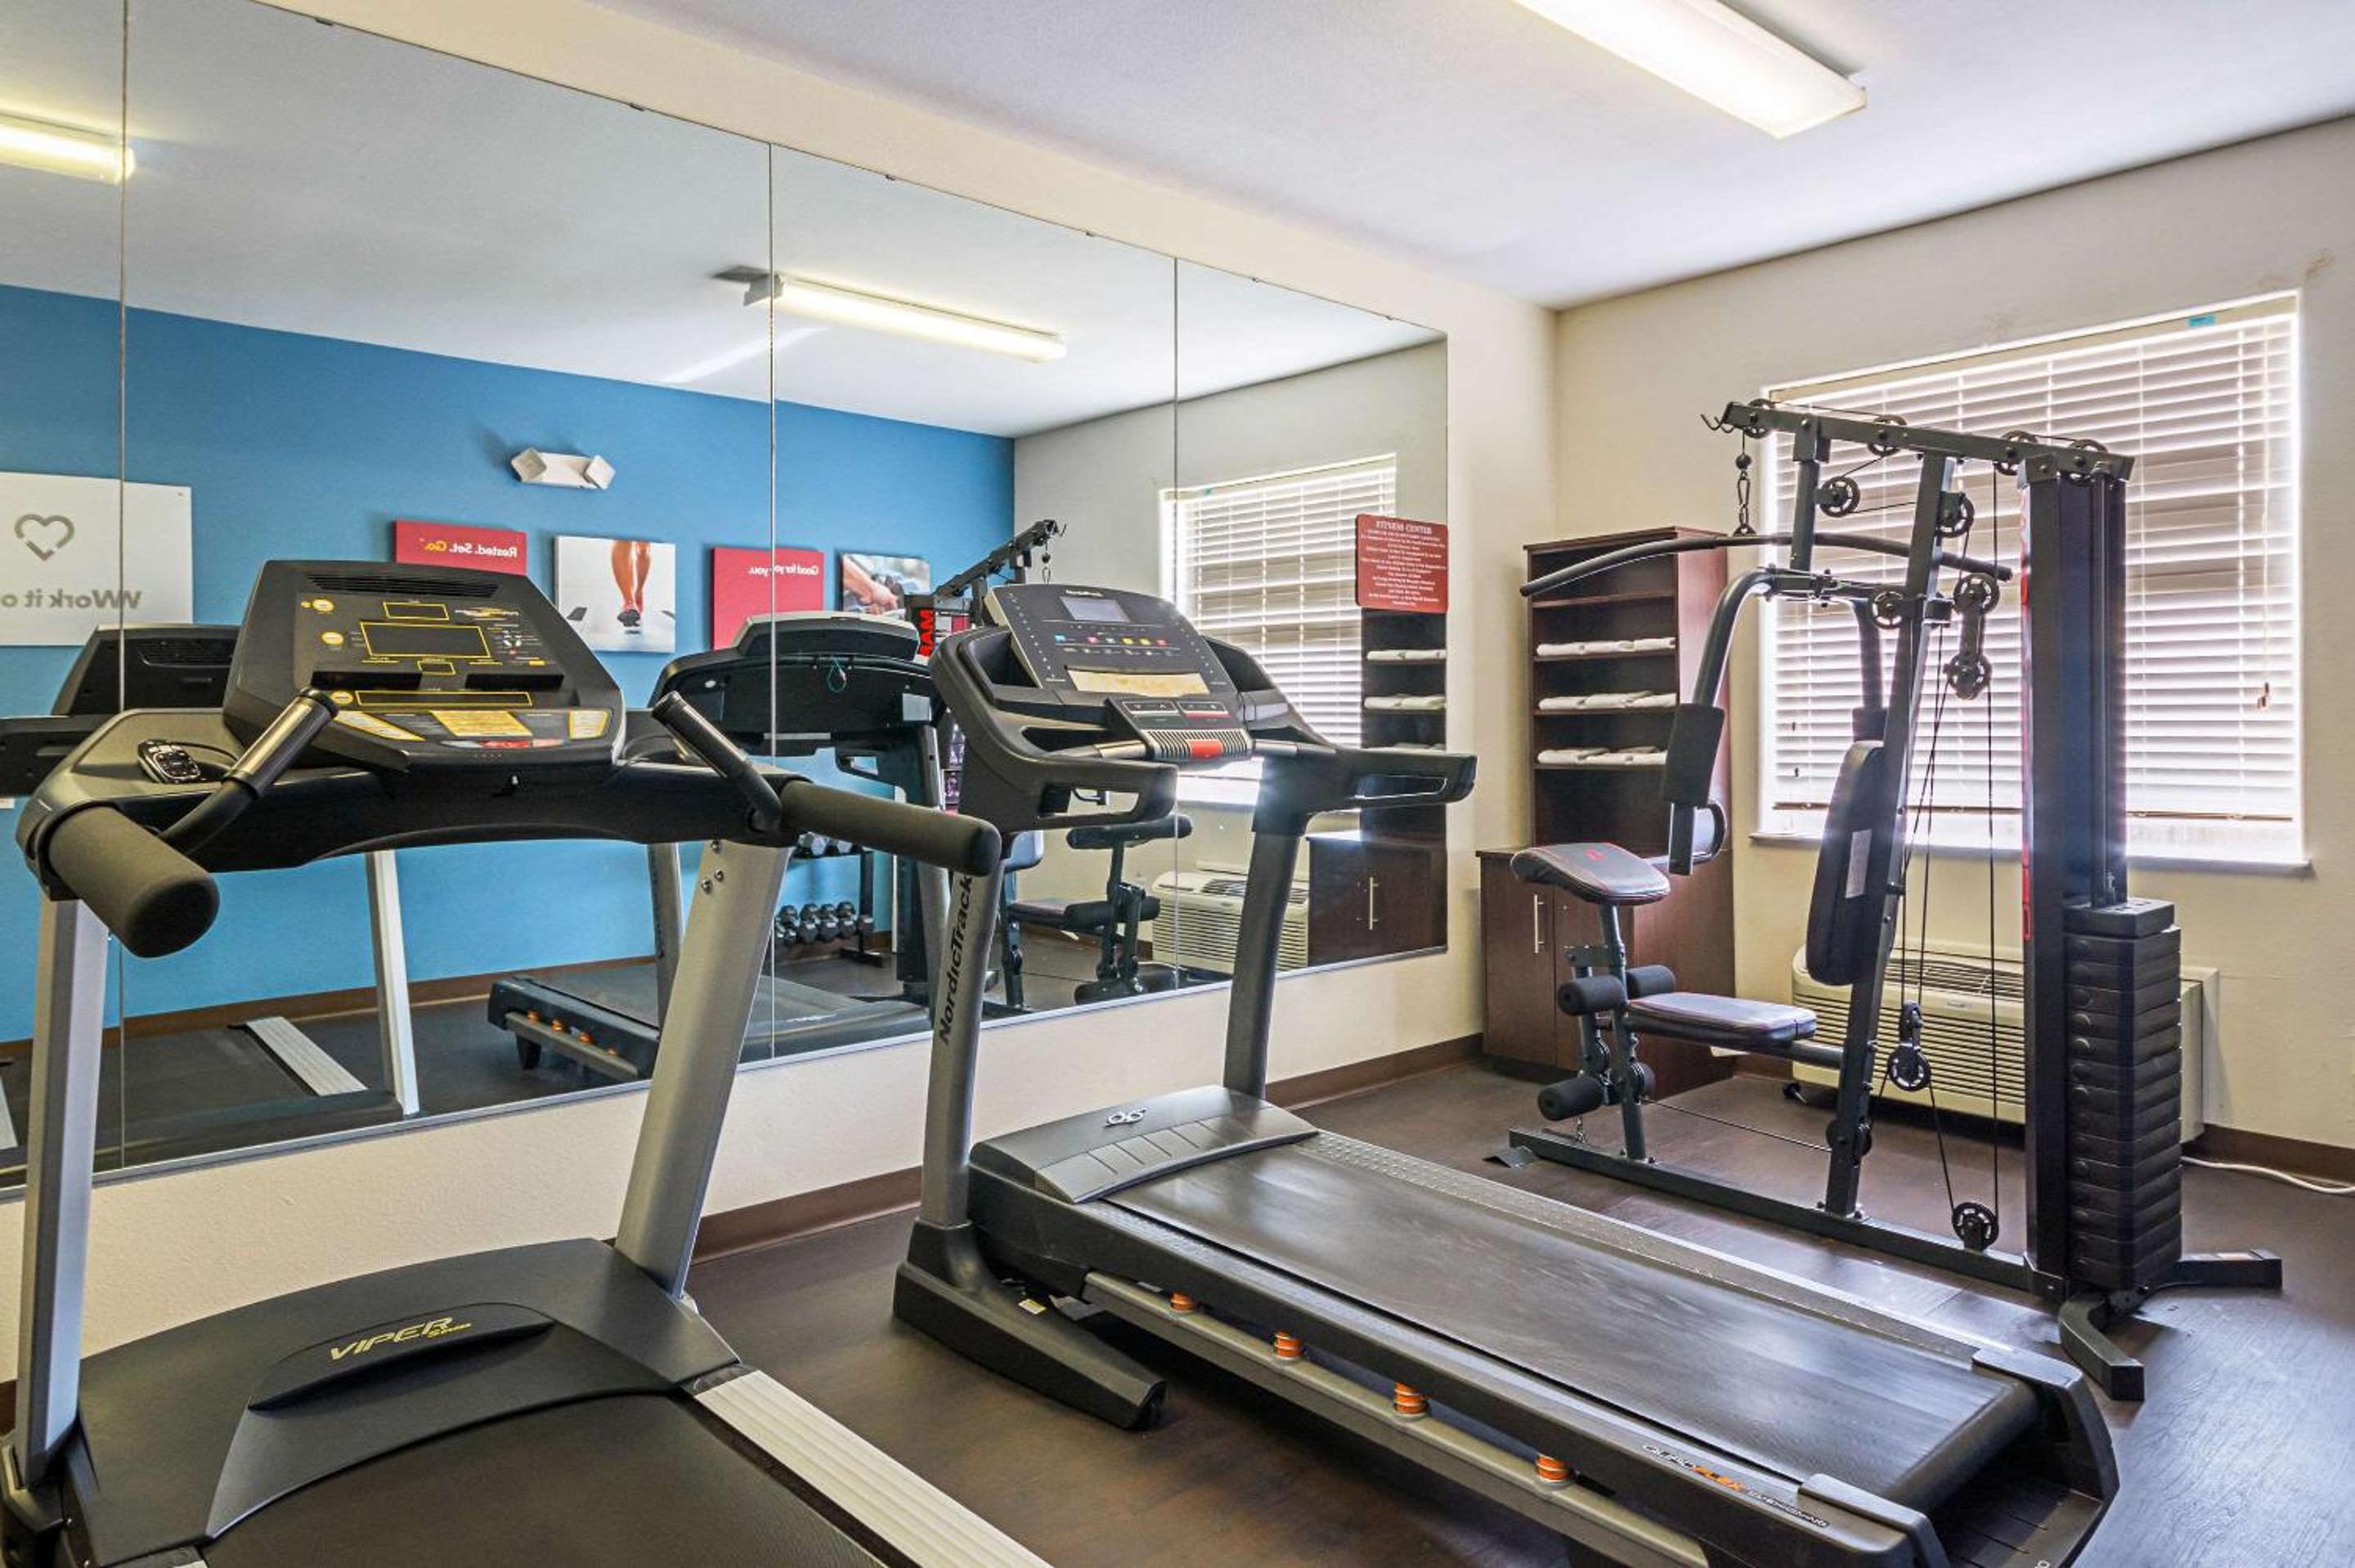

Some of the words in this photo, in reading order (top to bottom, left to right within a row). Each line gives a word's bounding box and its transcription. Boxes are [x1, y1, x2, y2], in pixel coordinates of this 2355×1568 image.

[1376, 520, 1404, 531] FITNESS
[1406, 524, 1433, 535] CENTER
[938, 876, 973, 1046] NordicTrack
[330, 1316, 452, 1360] VIPER
